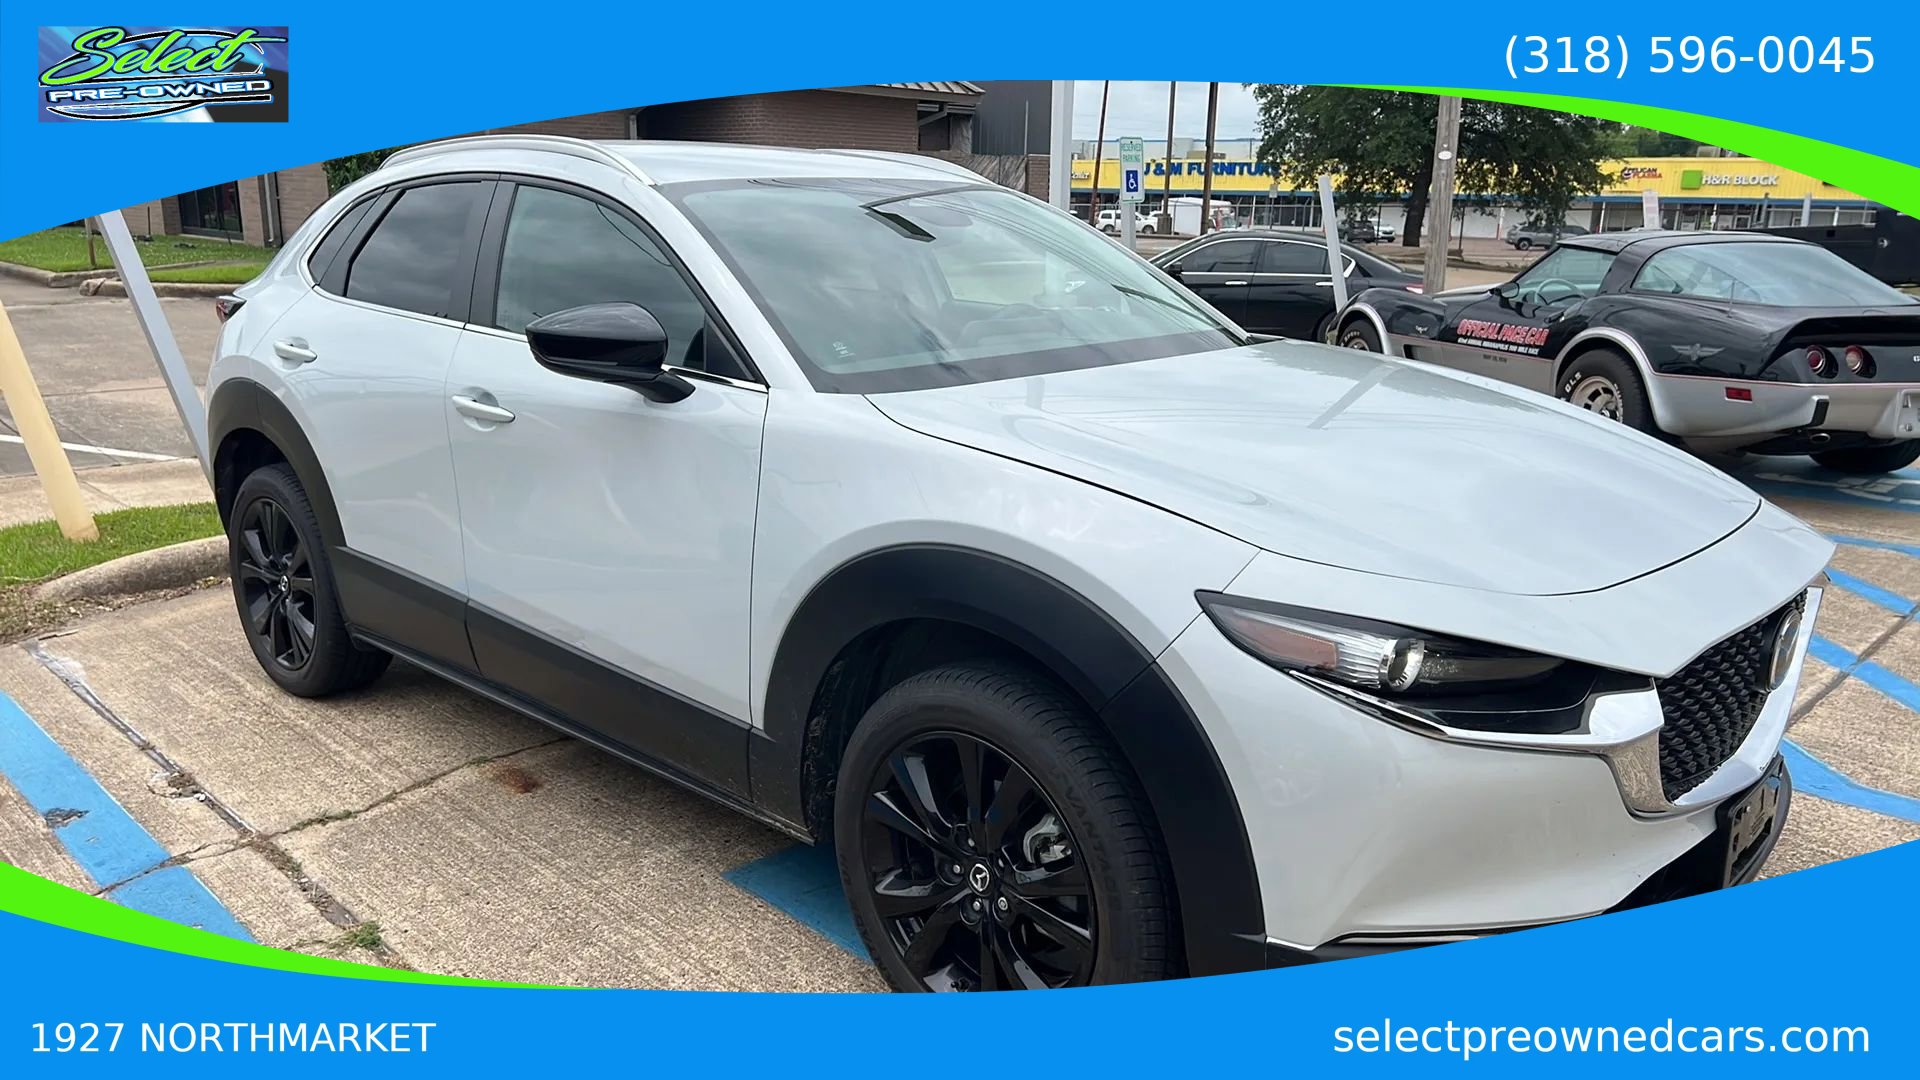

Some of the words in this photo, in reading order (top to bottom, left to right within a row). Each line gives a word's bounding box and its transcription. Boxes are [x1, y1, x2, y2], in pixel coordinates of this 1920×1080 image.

[1153, 162, 1165, 175] &
[1702, 175, 1730, 185] H&R
[1733, 175, 1778, 186] BLOCK
[1457, 319, 1500, 340] OFFICIAL
[1497, 324, 1528, 343] PACE
[1525, 327, 1550, 346] CAR
